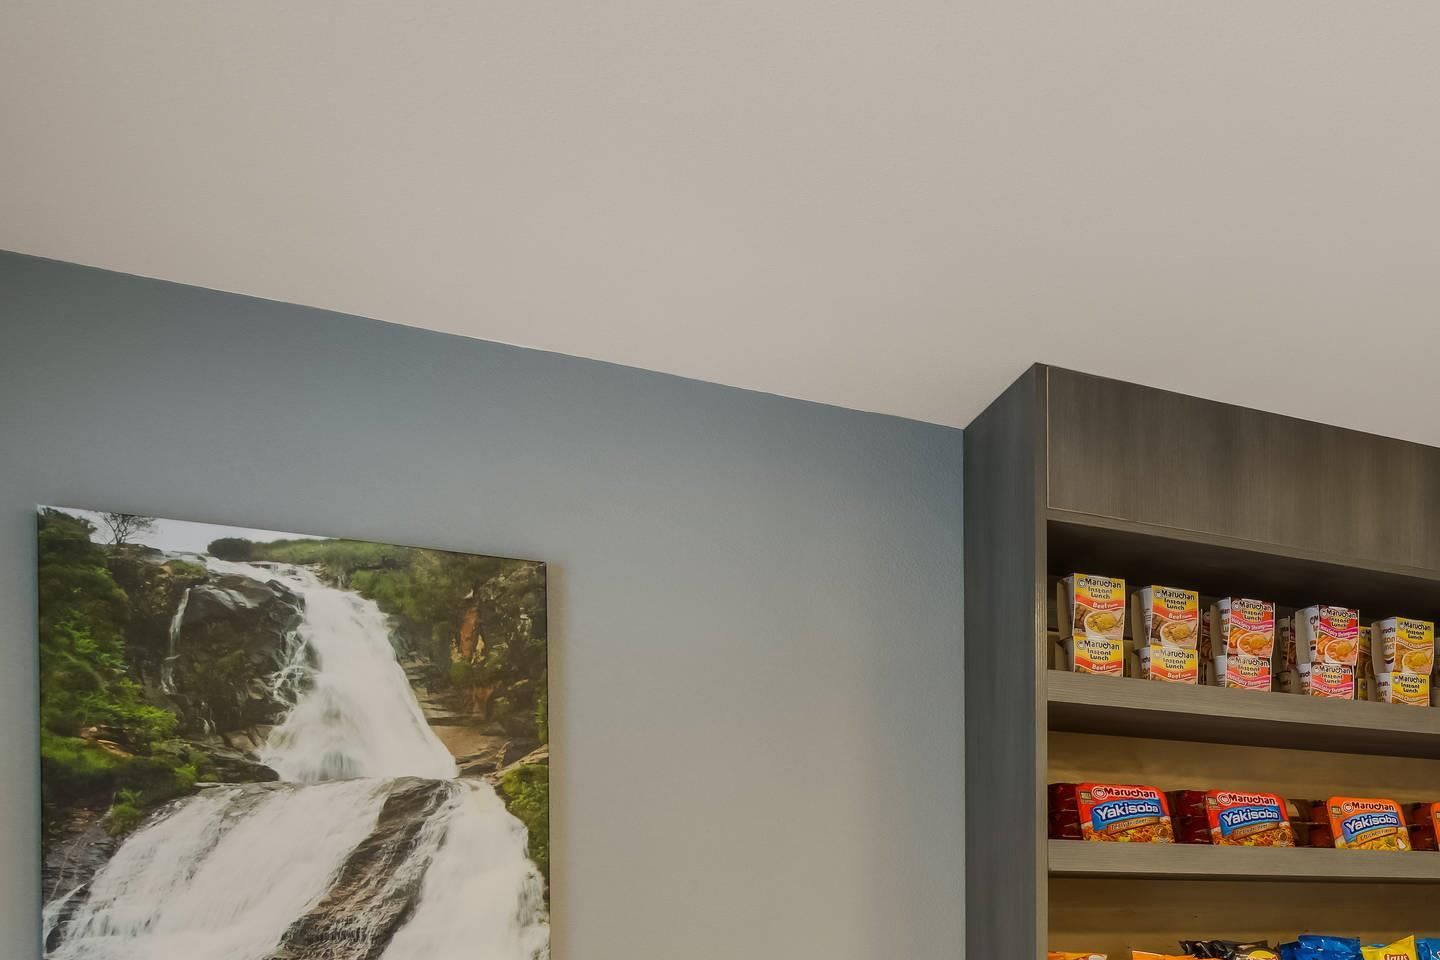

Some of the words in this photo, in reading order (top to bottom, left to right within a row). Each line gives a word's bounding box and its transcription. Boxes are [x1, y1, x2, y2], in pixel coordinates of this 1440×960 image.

[1085, 578, 1121, 589] Maruchan
[1088, 586, 1113, 594] Instant
[1161, 590, 1195, 600] Maruchan
[1240, 600, 1272, 611] Maruchan
[1327, 608, 1357, 618] Maruchan
[1404, 620, 1431, 631] Maruchan
[1084, 640, 1120, 650] Maruchan
[1161, 649, 1195, 659] Maruchan
[1320, 665, 1351, 674] Maruchan
[1399, 675, 1427, 685] Maruchan
[1104, 787, 1156, 798] Maruchan
[1228, 794, 1276, 805] Maruchan
[1096, 802, 1159, 820] Yakisoba
[1352, 801, 1395, 811] Maruchan
[1223, 809, 1278, 826] Yakisoba
[1345, 815, 1397, 833] Yakisoba
